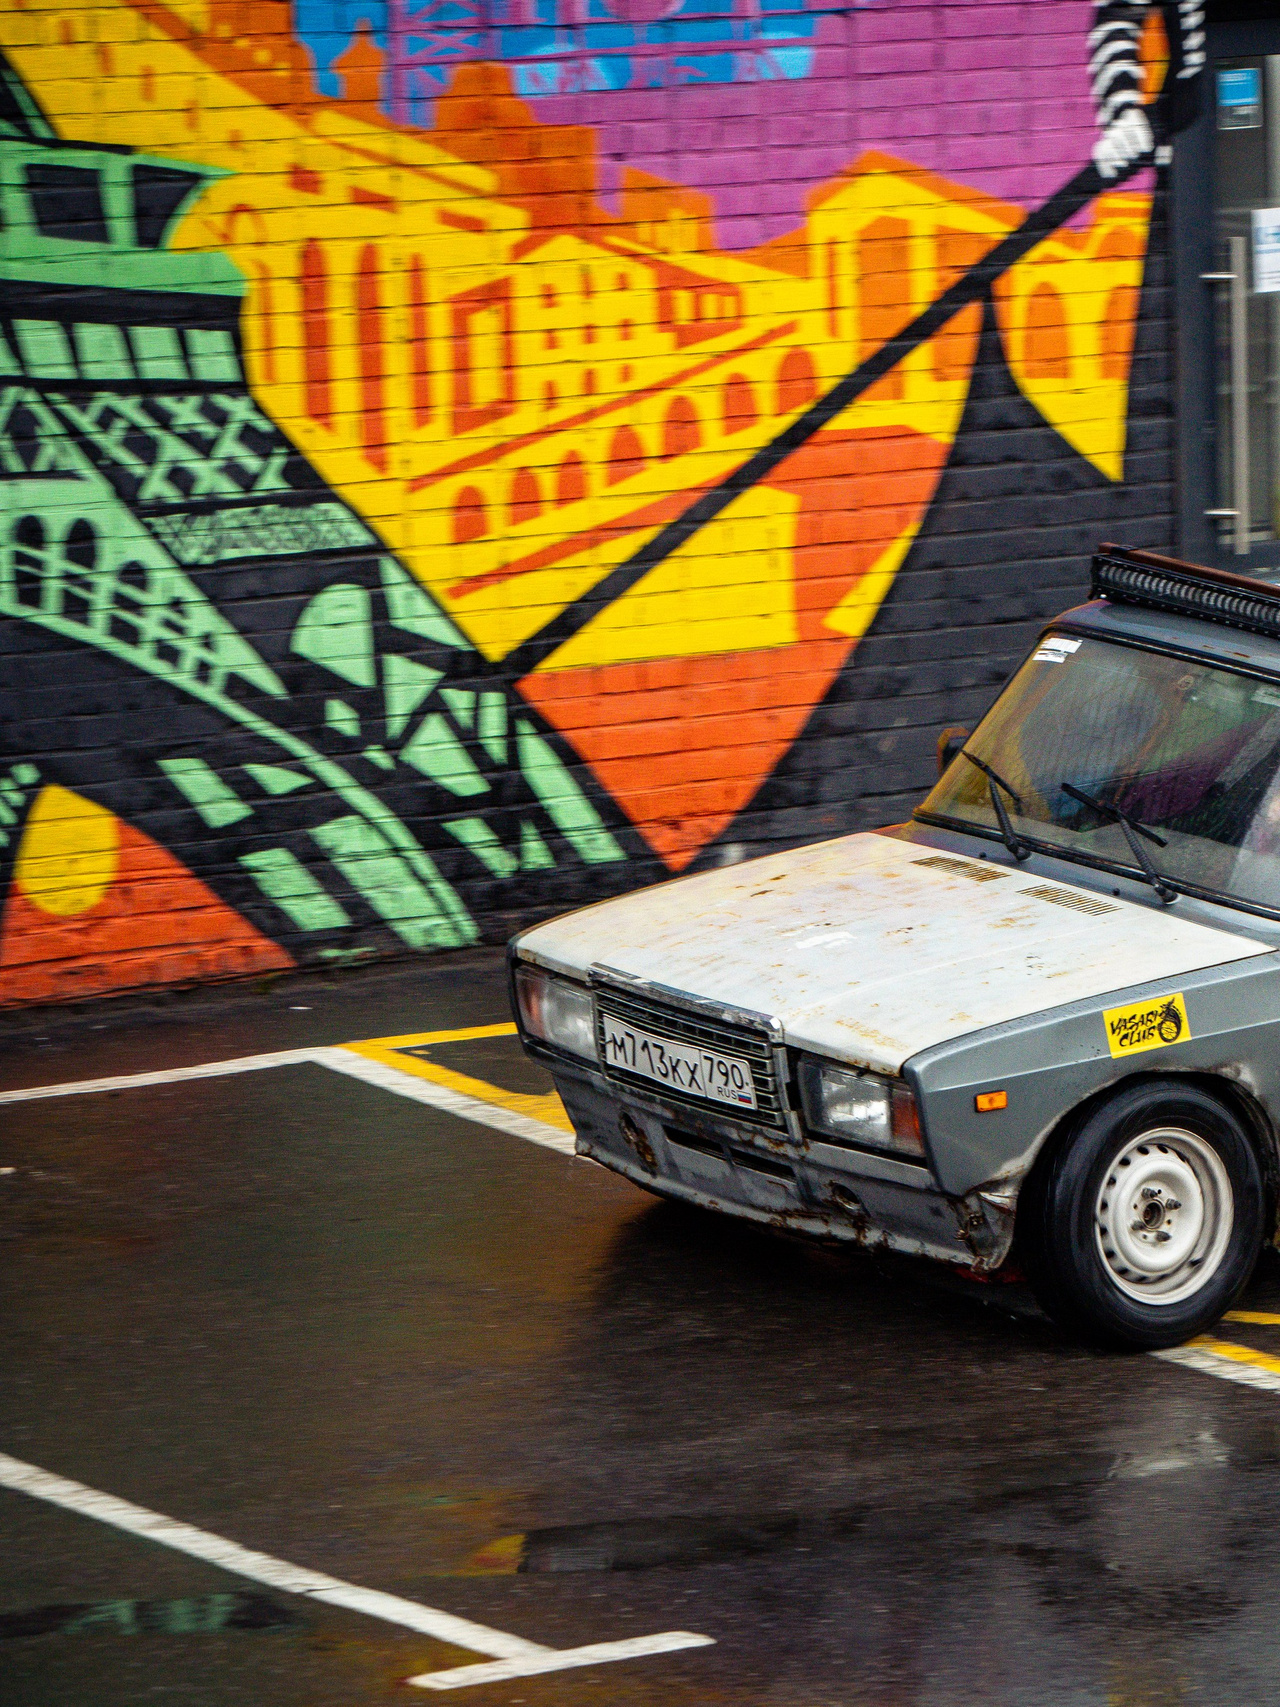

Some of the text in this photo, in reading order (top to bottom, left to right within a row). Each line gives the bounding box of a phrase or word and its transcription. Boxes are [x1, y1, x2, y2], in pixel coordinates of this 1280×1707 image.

[1119, 1025, 1156, 1047] CLUB
[703, 1055, 744, 1090] 790
[717, 1086, 737, 1100] RUS
